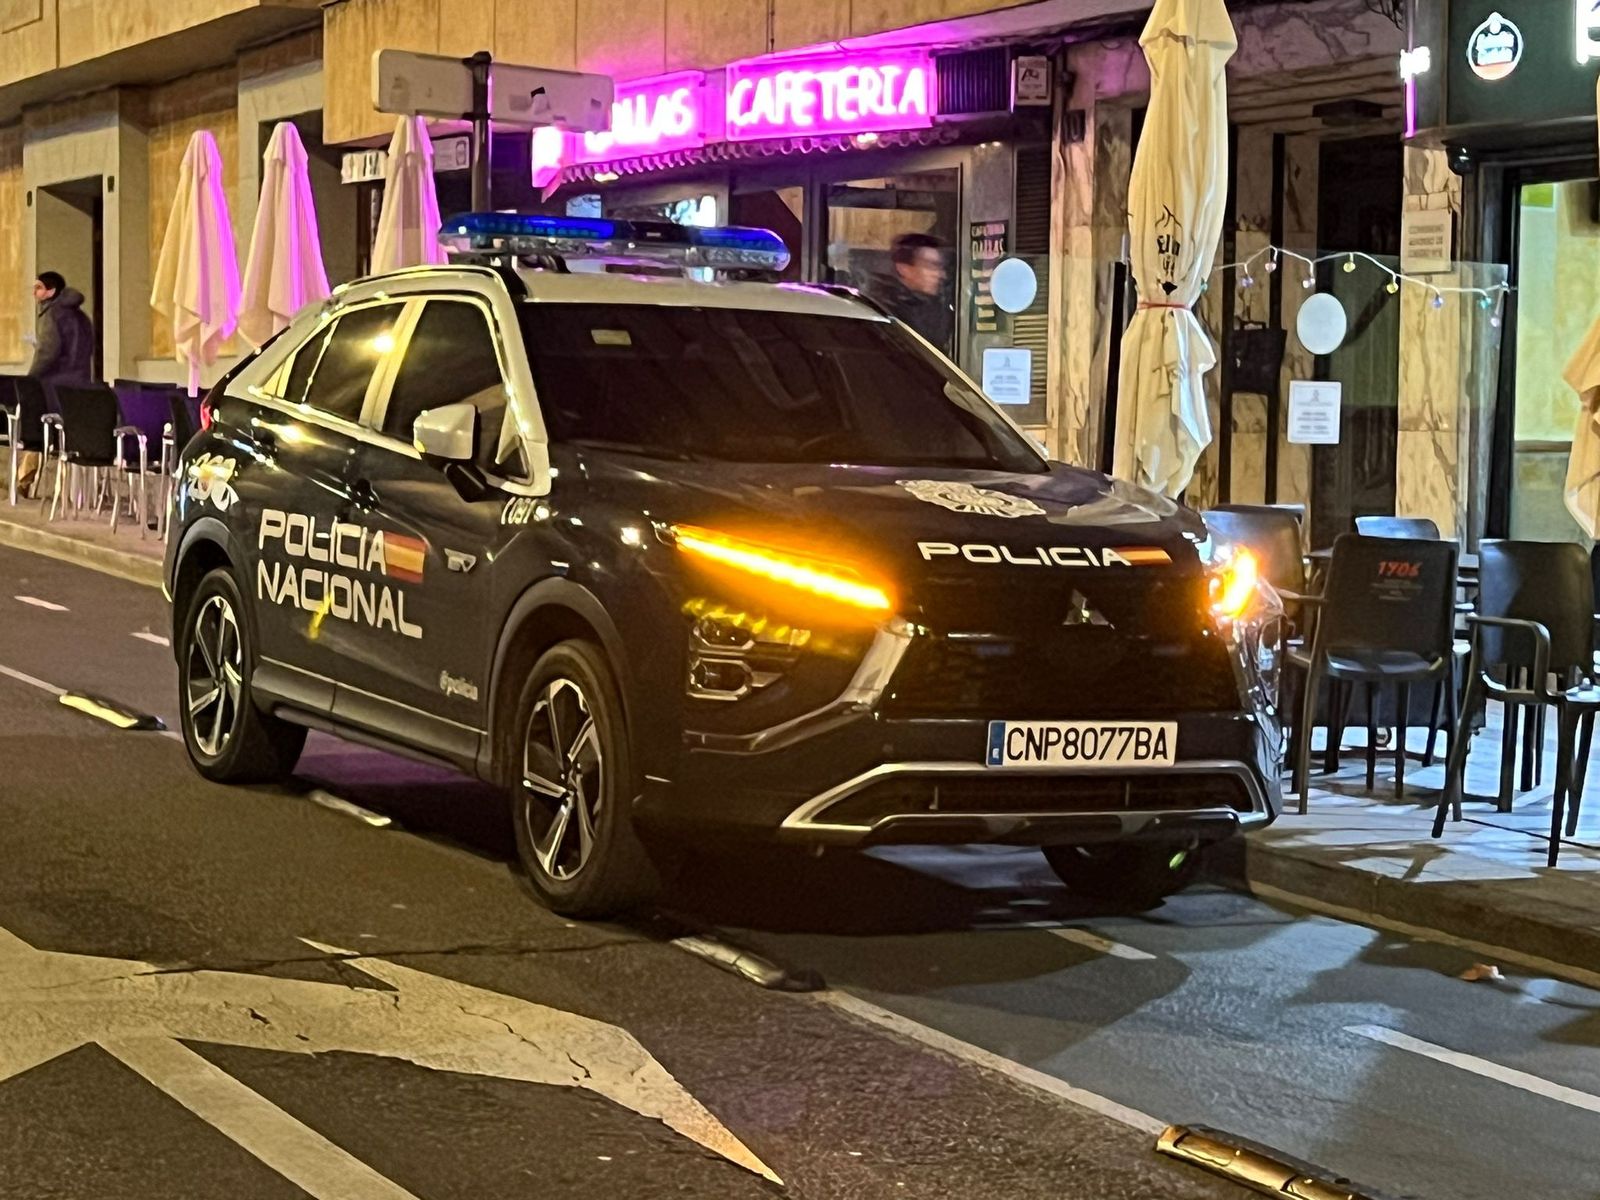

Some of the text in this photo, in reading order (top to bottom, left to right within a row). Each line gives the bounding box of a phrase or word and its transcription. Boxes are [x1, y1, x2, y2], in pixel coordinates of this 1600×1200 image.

[727, 65, 926, 126] CAFETERIA
[258, 508, 387, 576] POLICIA
[917, 541, 1132, 567] POLICIA
[257, 558, 423, 639] NACIONAL
[1006, 726, 1169, 761] CNP8077BA
